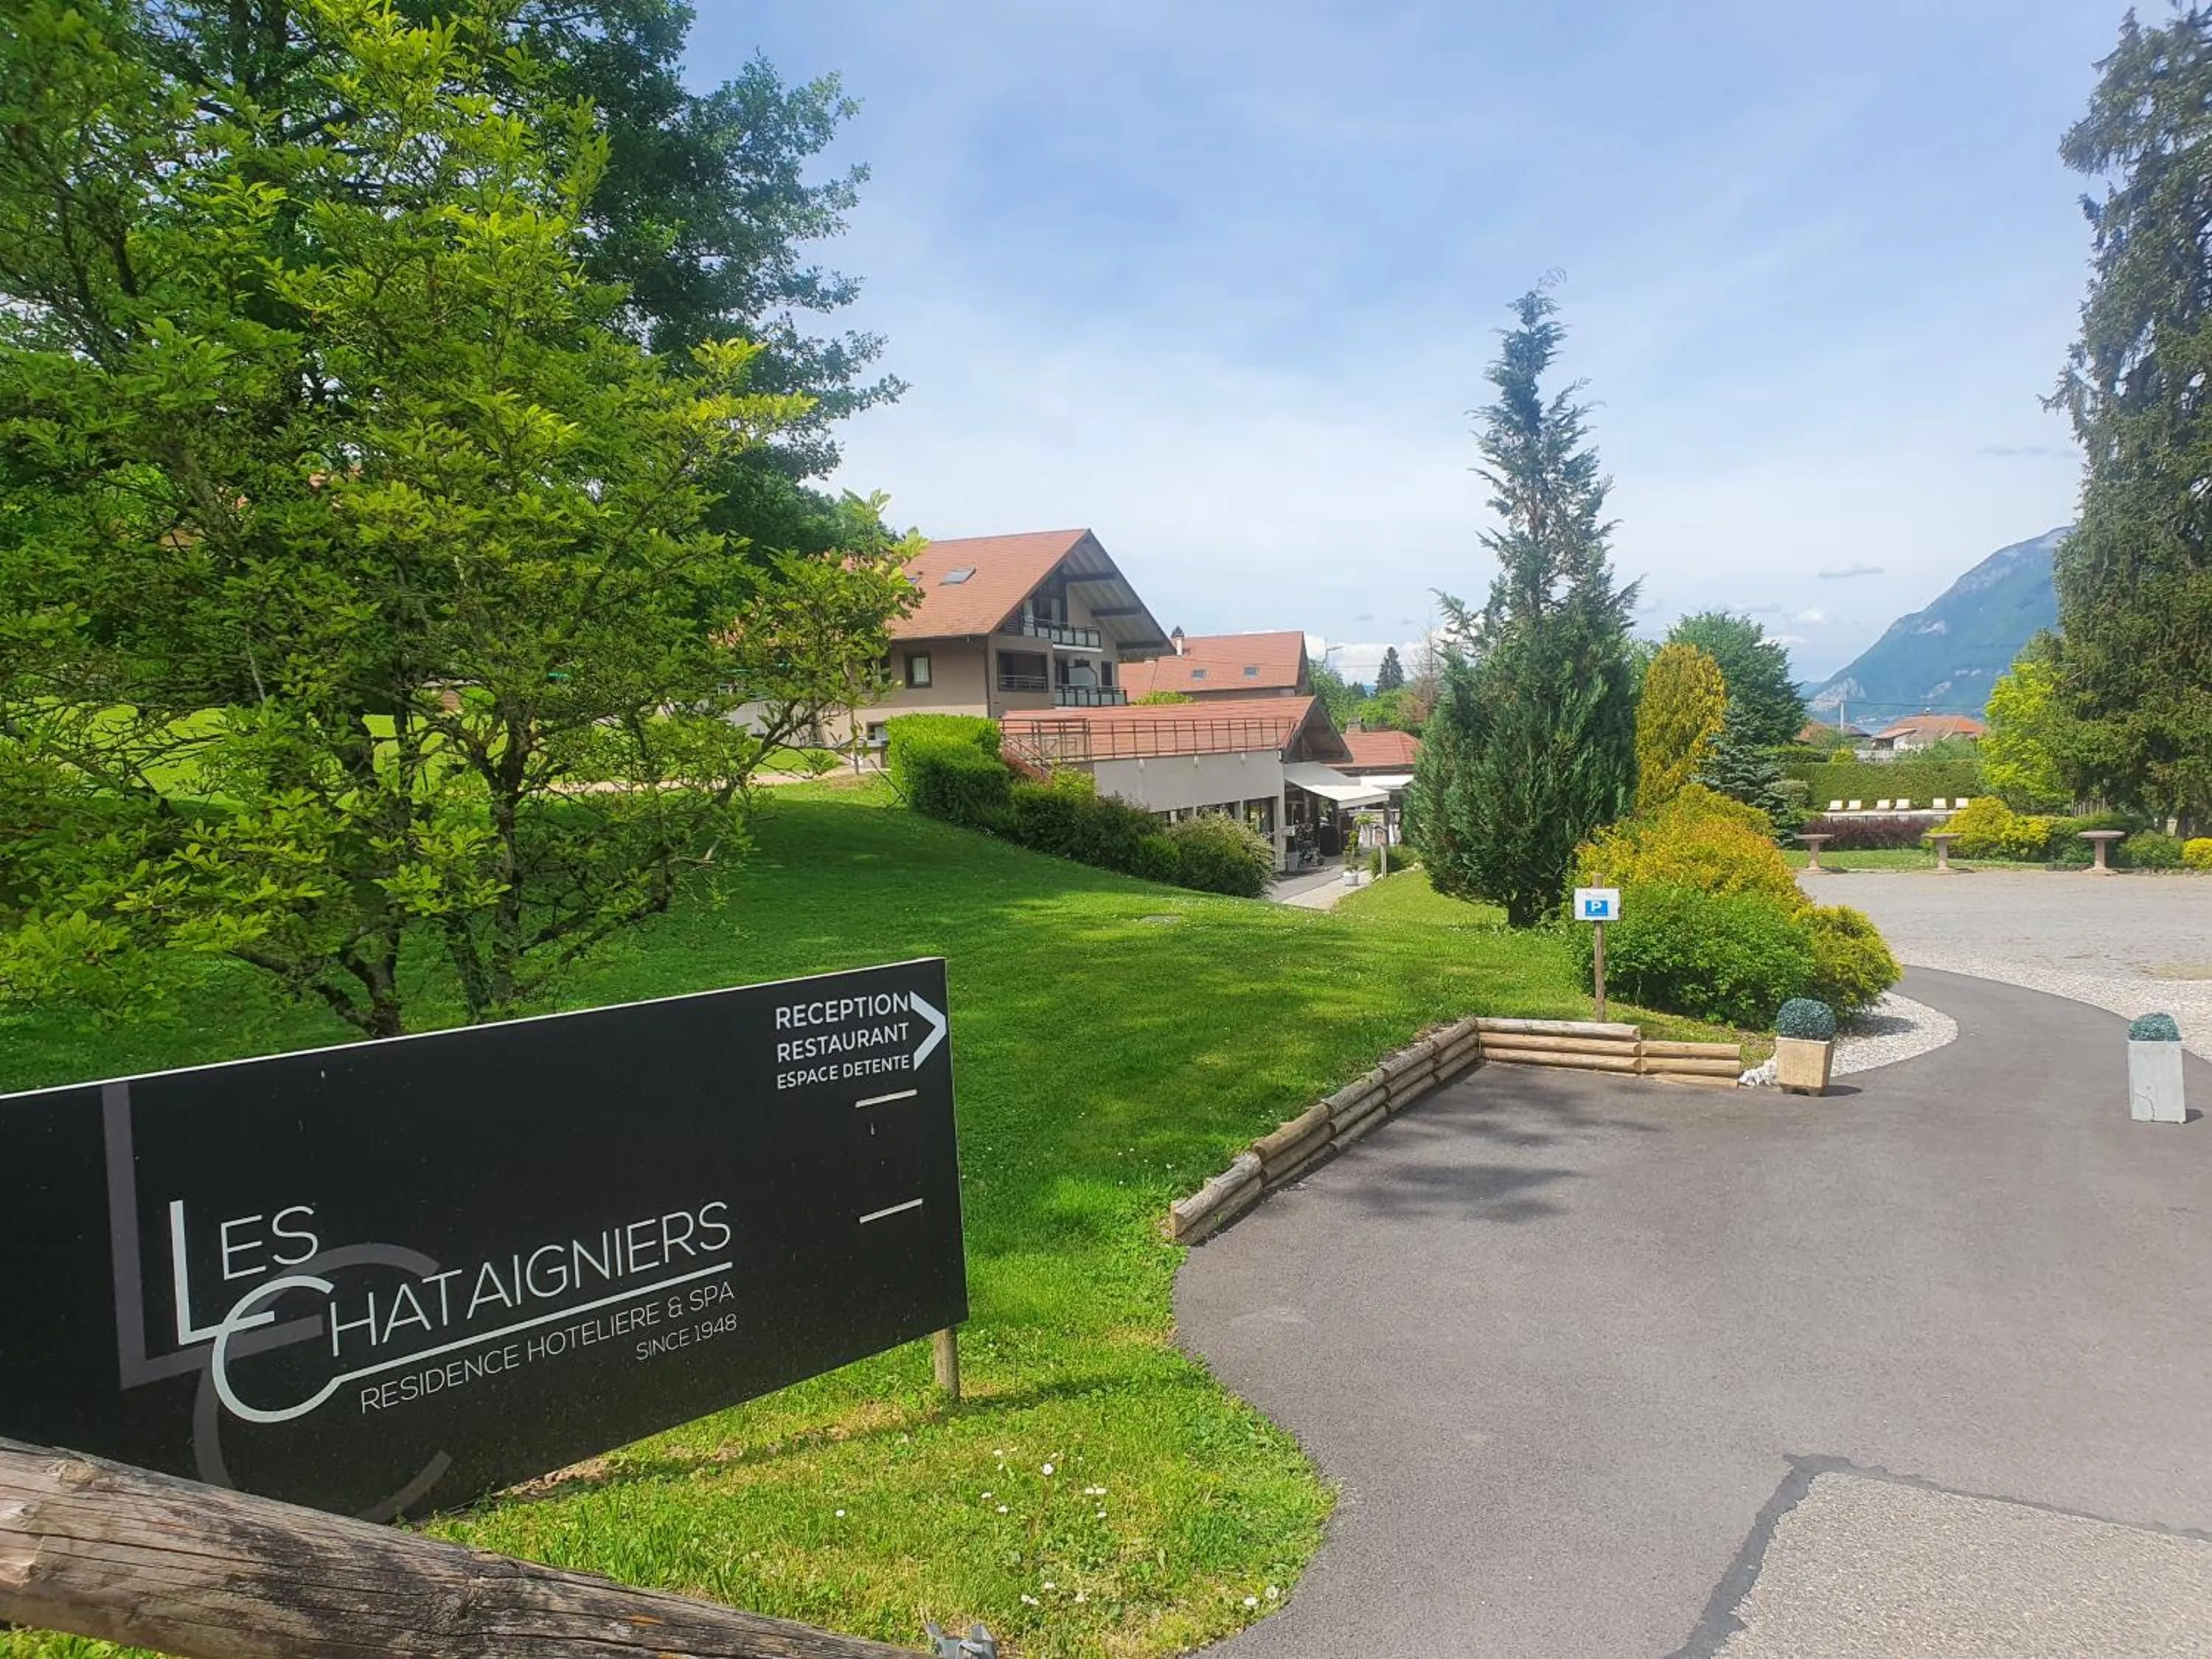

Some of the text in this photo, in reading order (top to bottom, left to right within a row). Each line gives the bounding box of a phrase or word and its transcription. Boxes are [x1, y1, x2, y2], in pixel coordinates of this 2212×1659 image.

[776, 992, 908, 1030] RECEPTION
[776, 1022, 909, 1063] RESTAURANT
[776, 1054, 910, 1090] ESPACE DETENTE
[170, 1200, 319, 1346] LES
[212, 1200, 733, 1424] CHATAIGNIERS
[636, 1312, 737, 1361] SINCE 1948
[360, 1281, 735, 1414] RESIDENCE HOTELIERE & SPA
